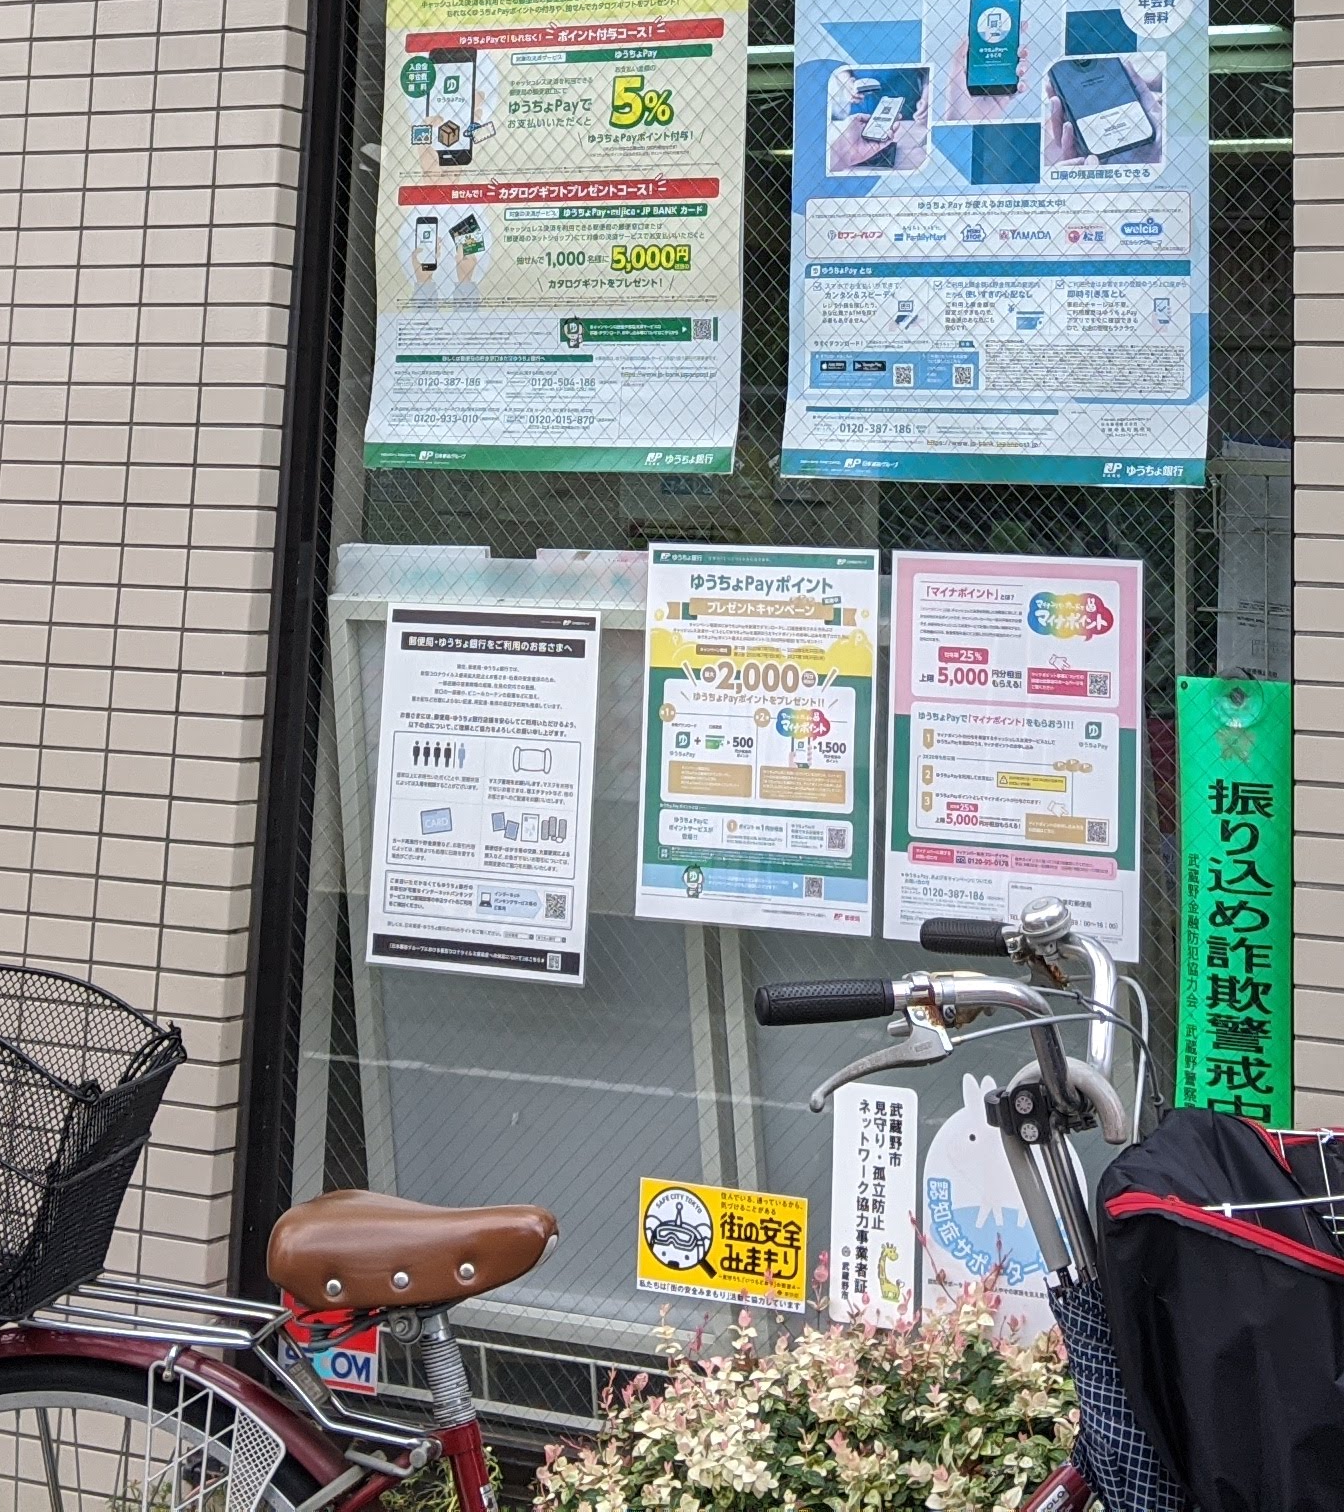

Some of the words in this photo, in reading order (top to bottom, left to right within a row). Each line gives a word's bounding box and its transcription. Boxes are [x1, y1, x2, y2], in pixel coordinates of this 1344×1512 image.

[1143, 10, 1170, 24] 無料
[557, 26, 654, 43] ポイント付与コース！
[614, 48, 658, 60] ゆうちょPay
[508, 96, 592, 114] ゆうちょPayで
[609, 74, 674, 129] 5%
[507, 116, 592, 129] お支払いいただくと
[1050, 169, 1151, 181] 口座の残高確認もできる
[498, 182, 654, 200] カタログギフトプレゼントコース！
[1010, 230, 1052, 240] YAMADA
[1123, 222, 1162, 235] welcia
[417, 377, 481, 387] 0120-387-186
[839, 423, 912, 435] 0120-387-186
[665, 454, 713, 465] ゆうちょ銀行
[1127, 465, 1184, 478] ゆうちょ銀行
[690, 574, 833, 596] ゆうちょPayポイント
[707, 601, 815, 616] プレゼントキャンペーン
[1034, 610, 1108, 630] マイナポイント
[409, 636, 573, 653] 郵便局・ゆうちょ銀行をご利用のお客さまへ
[715, 661, 800, 694] 2,000
[938, 667, 989, 686] 5,000
[733, 737, 754, 748] 500
[818, 742, 847, 754] 1,500
[425, 817, 449, 829] CARD
[946, 813, 979, 826] 5,000
[668, 825, 713, 833] ポイントサービスが
[922, 887, 985, 901] 0120-387-186
[1187, 854, 1200, 1009] 武蔵野金融防犯協力会
[1207, 779, 1275, 1124] 振り込め詐欺警戒中
[890, 1102, 903, 1167] 武蔵野市
[872, 1101, 886, 1231] 見守り・孤立防止
[656, 1196, 670, 1209] SAFE
[670, 1193, 684, 1201] CITY
[685, 1196, 703, 1214] TOKYO
[721, 1192, 803, 1210] 住んでいる、通っているから、
[855, 1098, 869, 1296] ネットワーク協力事業者証
[721, 1202, 776, 1216] 気づけることがある
[720, 1212, 802, 1250] 街の安全
[928, 1179, 1049, 1285] 認知症サポター
[720, 1244, 800, 1280] みまもり
